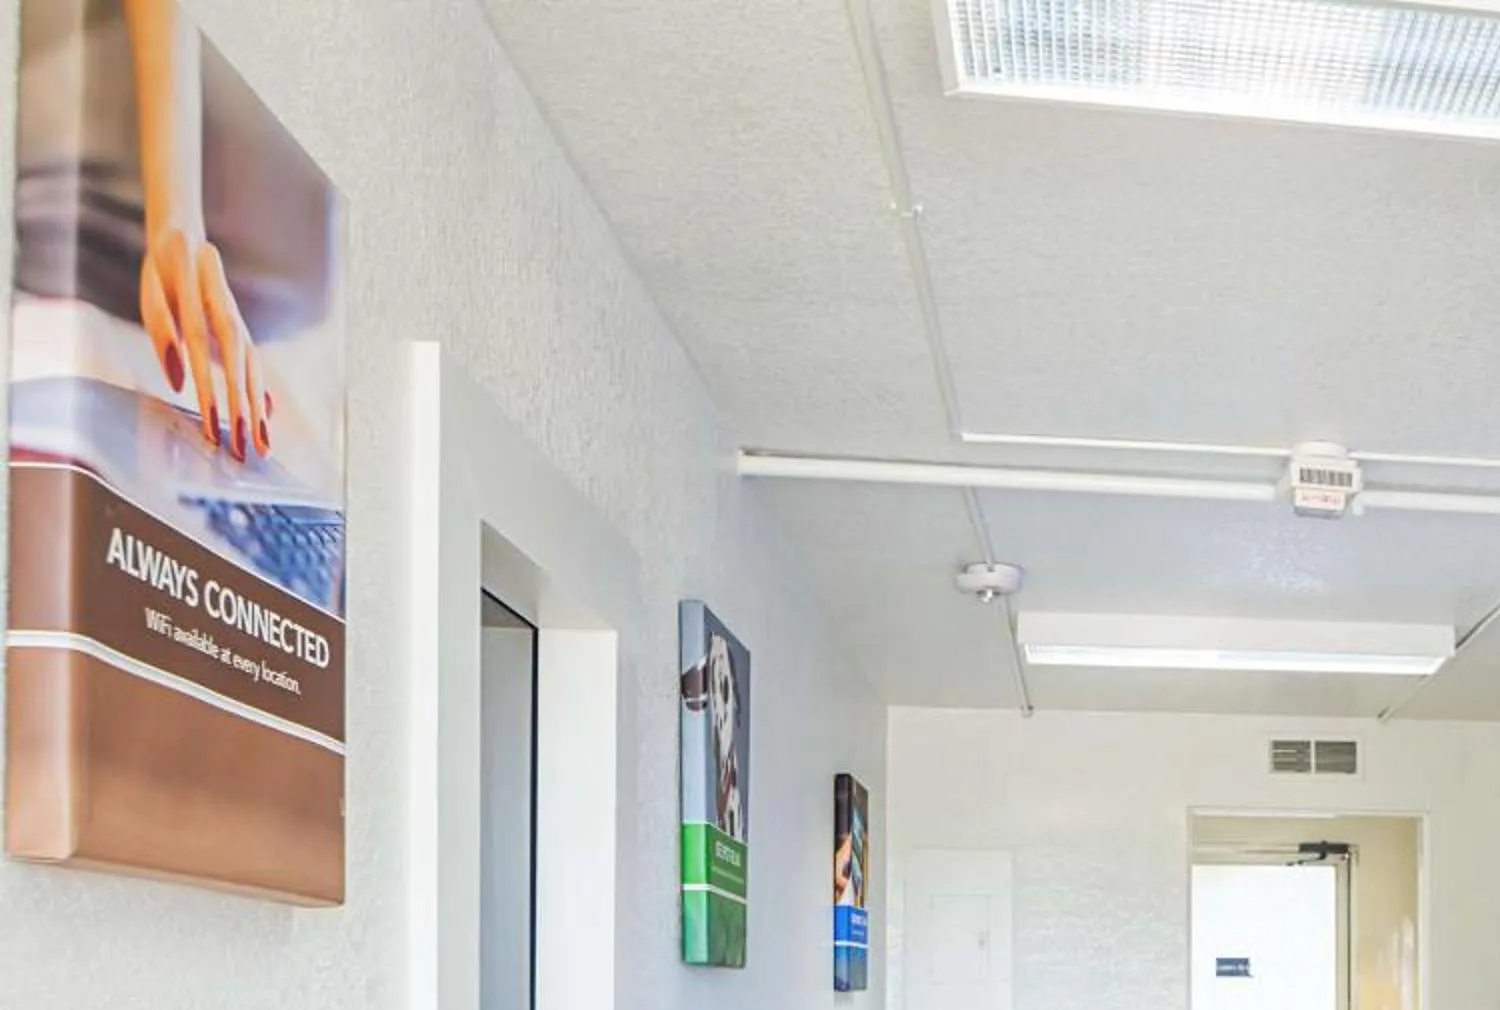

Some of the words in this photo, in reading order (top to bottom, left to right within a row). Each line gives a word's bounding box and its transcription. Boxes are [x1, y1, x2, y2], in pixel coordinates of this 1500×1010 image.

[106, 527, 199, 607] ALWAYS
[203, 580, 330, 669] CONNECTED
[144, 607, 173, 638] WiFi
[174, 626, 218, 659] available
[220, 647, 232, 665] at
[233, 654, 261, 682] every
